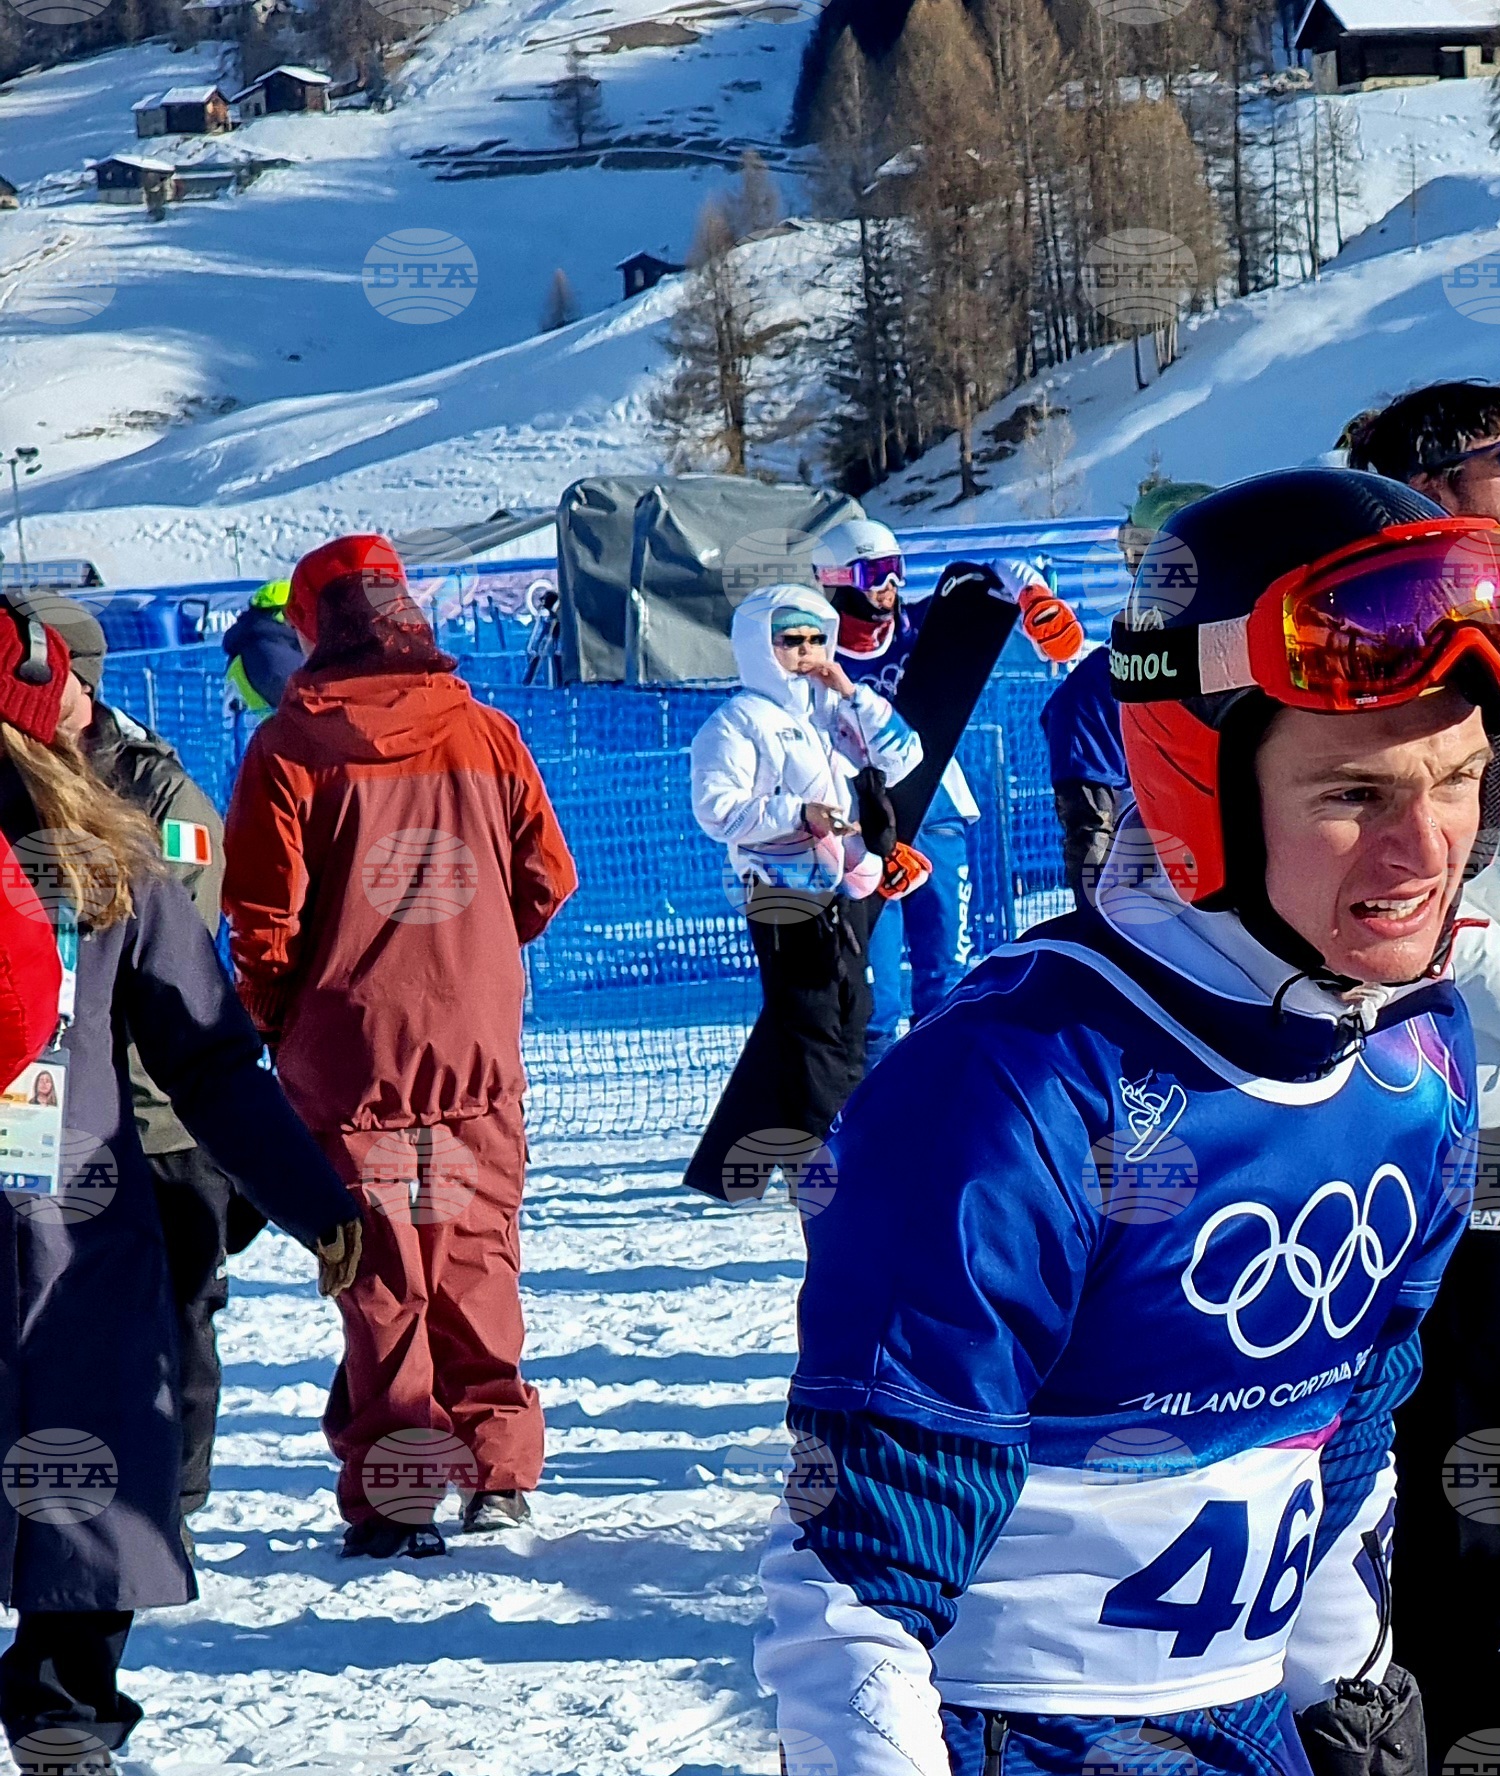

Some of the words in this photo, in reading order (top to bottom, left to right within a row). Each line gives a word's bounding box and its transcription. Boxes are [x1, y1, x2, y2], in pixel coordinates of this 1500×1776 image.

[1118, 1386, 1266, 1415] MILANO
[1270, 1360, 1351, 1407] CORTINA
[1097, 1478, 1315, 1659] 46
